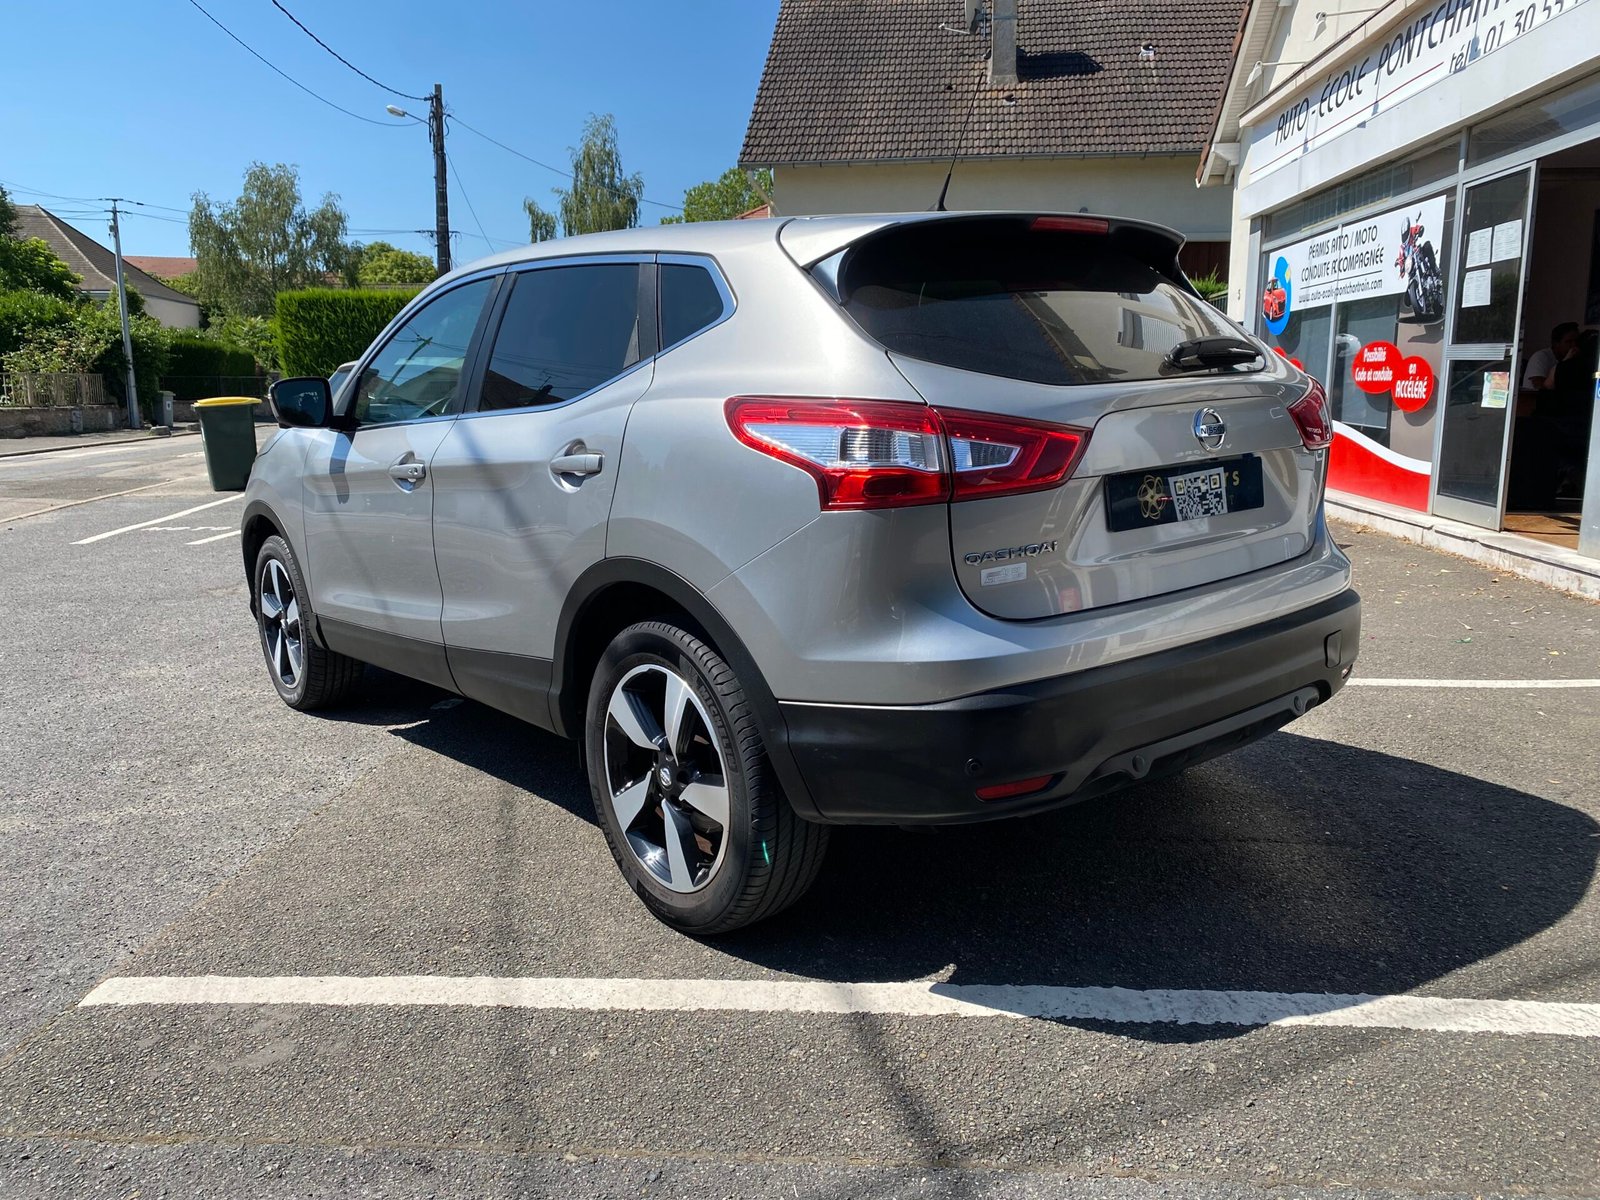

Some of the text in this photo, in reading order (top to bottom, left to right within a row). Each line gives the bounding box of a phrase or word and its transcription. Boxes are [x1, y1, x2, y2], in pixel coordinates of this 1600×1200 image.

[1483, 20, 1506, 55] 01
[1514, 2, 1537, 37] 30
[1275, 97, 1310, 146] AUTO
[1319, 58, 1370, 118] ÉCOLE
[1373, 0, 1510, 85] PONTCHA
[1308, 239, 1330, 260] PERMIS
[1331, 234, 1349, 254] AUTO
[1354, 225, 1378, 247] MOTO
[1301, 243, 1384, 282] CONDUITE ACCOMPAGNÉE
[1363, 346, 1387, 363] Possibilité
[1408, 363, 1417, 375] en
[1355, 366, 1393, 382] Code et conduite
[1395, 376, 1428, 399] ACCÉLÉRÉ
